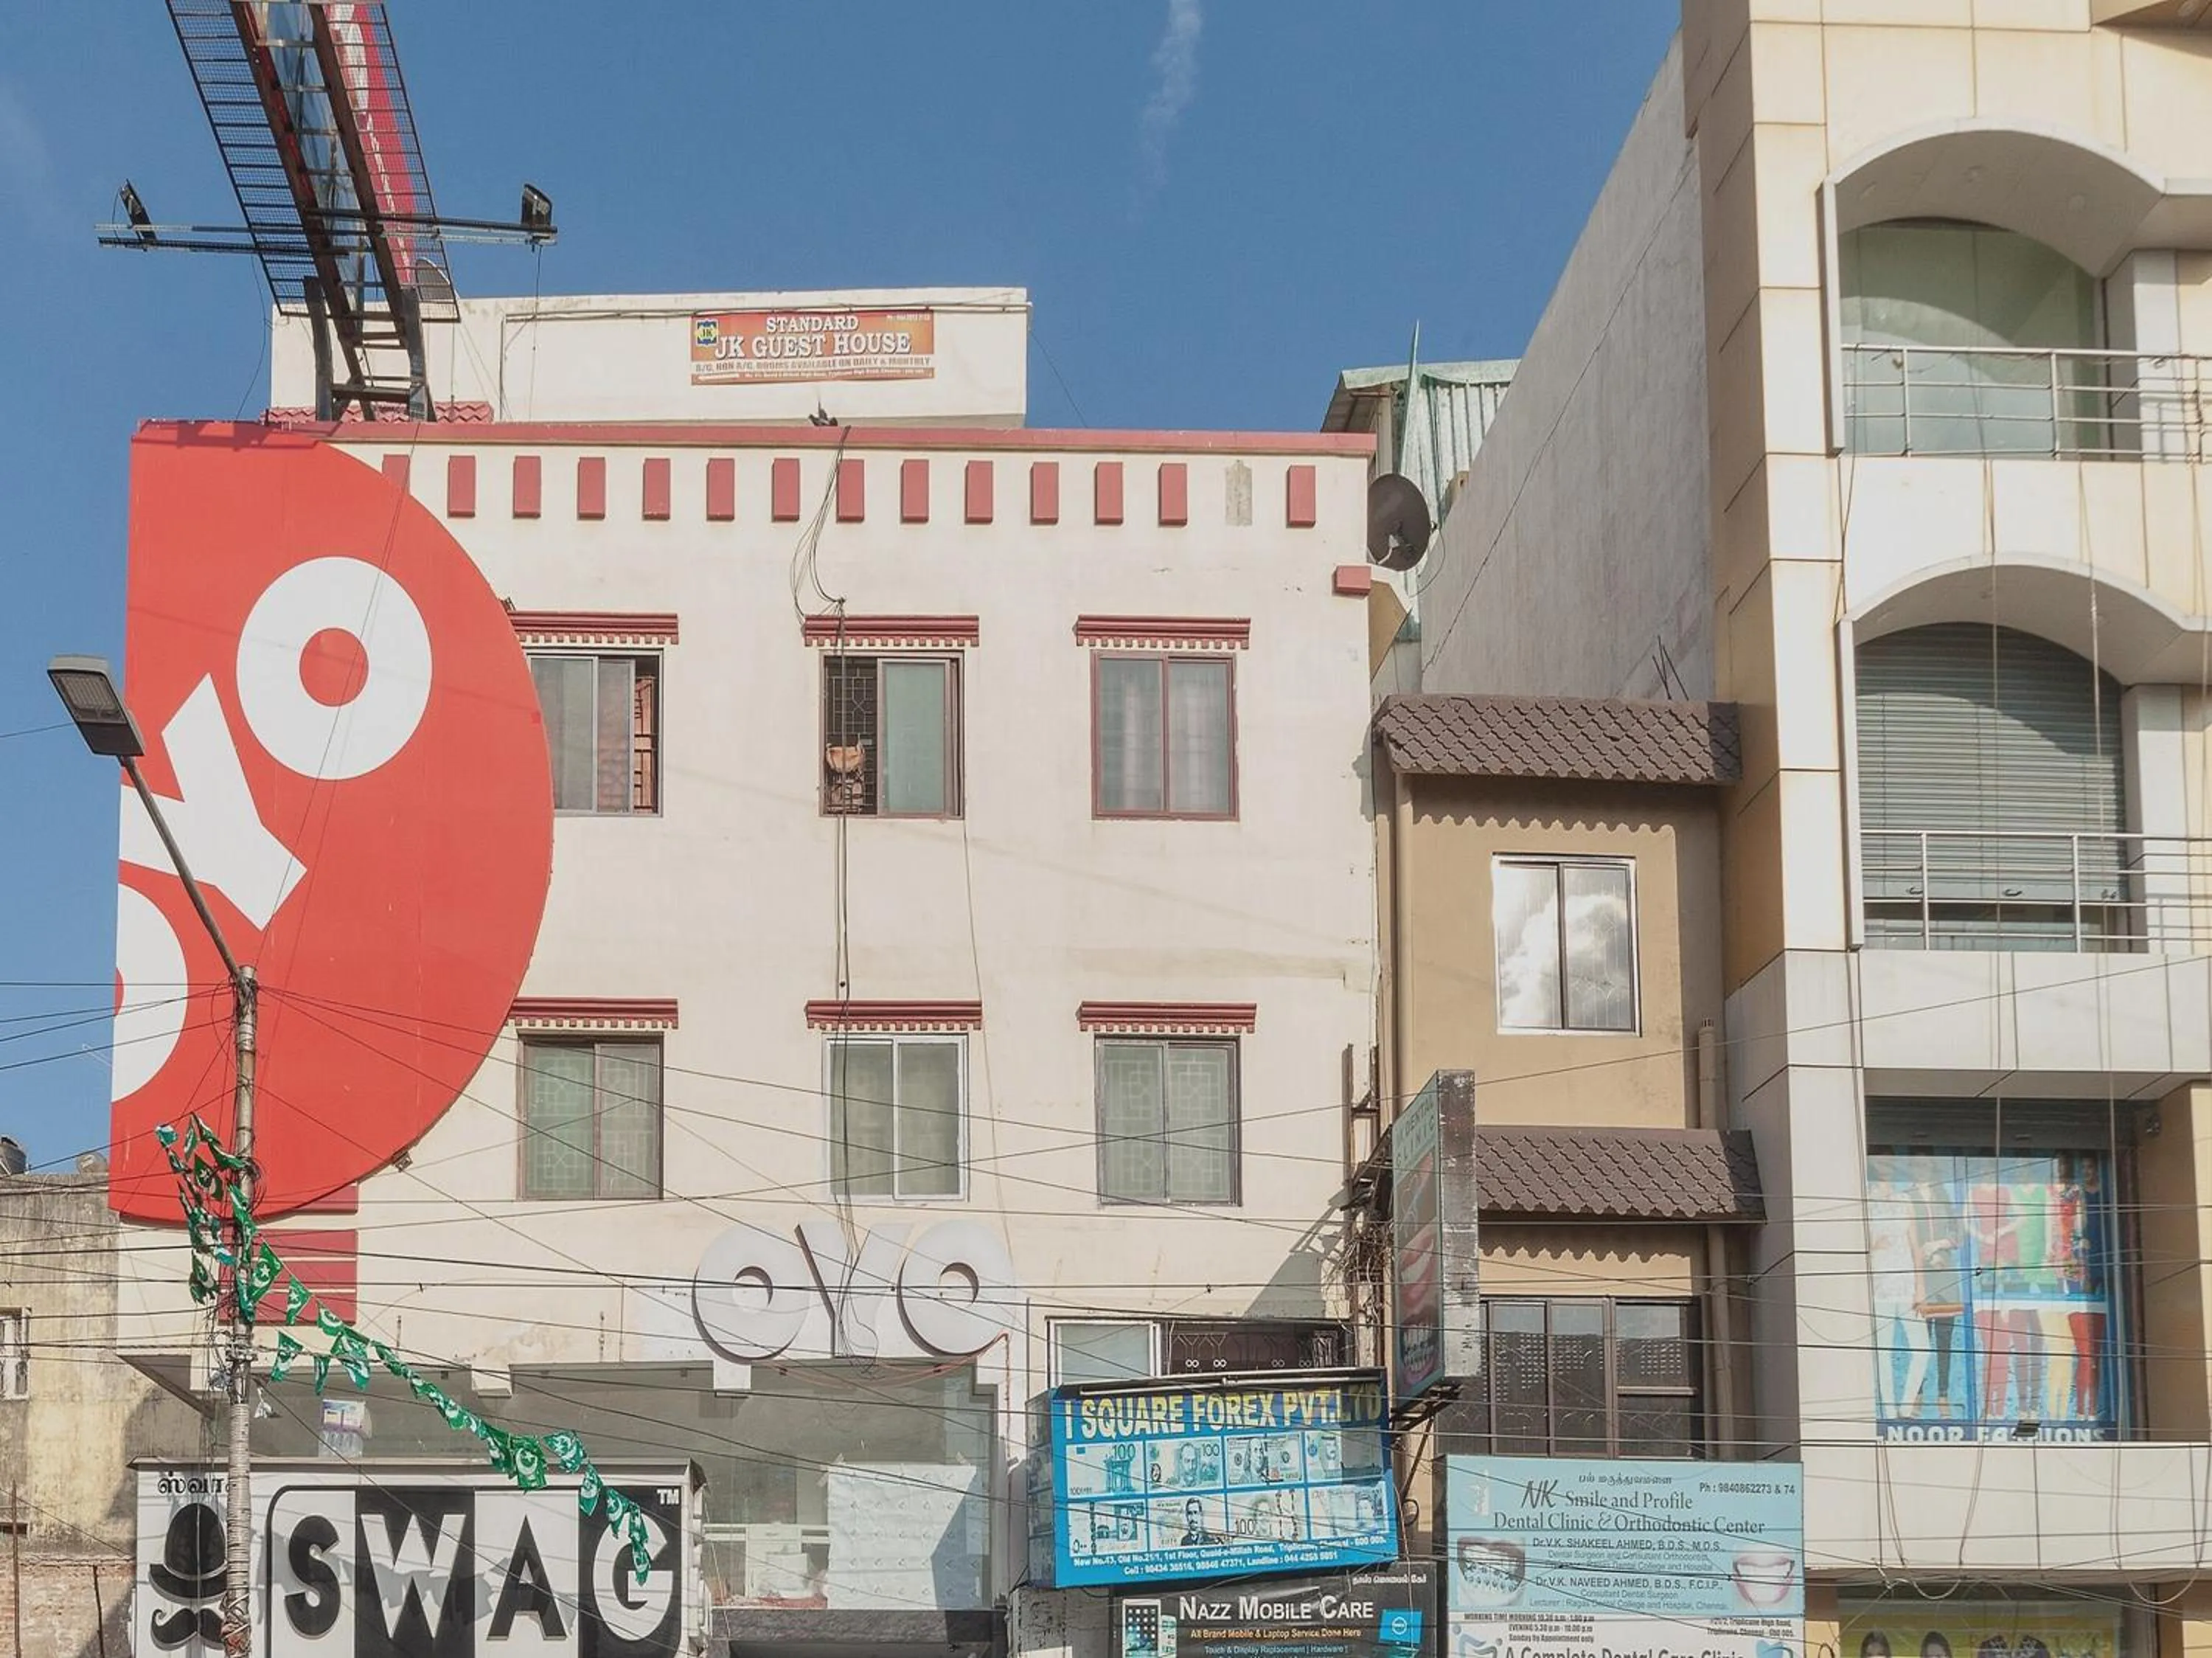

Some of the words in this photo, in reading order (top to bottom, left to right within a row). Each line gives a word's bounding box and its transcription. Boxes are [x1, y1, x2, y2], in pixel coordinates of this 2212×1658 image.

[767, 316, 859, 333] STANDARD
[714, 336, 745, 358] JK
[752, 334, 826, 358] GUEST
[833, 333, 911, 355] HOUSE
[853, 357, 877, 367] DAILY
[692, 1220, 1016, 1364] OYO
[1081, 1394, 1186, 1440] SQUARE
[1192, 1391, 1277, 1432] FOREX
[1112, 1443, 1136, 1460] 100
[1202, 1443, 1220, 1457] 100
[1522, 1480, 1558, 1509] NK
[1565, 1490, 1605, 1508] Smile
[1611, 1491, 1639, 1509] and
[1643, 1491, 1694, 1510] Profile
[1699, 1482, 1711, 1493] Ph
[657, 1488, 679, 1505] TM
[1235, 1517, 1255, 1536] 100
[1494, 1511, 1544, 1530] Dental
[1548, 1512, 1593, 1530] Clinic
[1598, 1511, 1611, 1530] &
[1614, 1513, 1711, 1533] Orthodontic
[1714, 1516, 1765, 1534] Center
[1567, 1538, 1614, 1549] SHAKEEL
[1615, 1539, 1656, 1550] AHMED,
[283, 1511, 674, 1642] SWAG
[1570, 1576, 1610, 1588] NAVEED
[1203, 1628, 1226, 1638] Brand
[1228, 1628, 1253, 1638] Mobile
[1255, 1629, 1262, 1638] &
[1263, 1628, 1290, 1640] Laptop
[1291, 1628, 1319, 1638] Service
[1321, 1628, 1342, 1637] Done
[1343, 1628, 1361, 1637] Here
[1205, 1645, 1225, 1654] Touch
[1234, 1645, 1259, 1656] Display
[1260, 1645, 1306, 1655] Replacement
